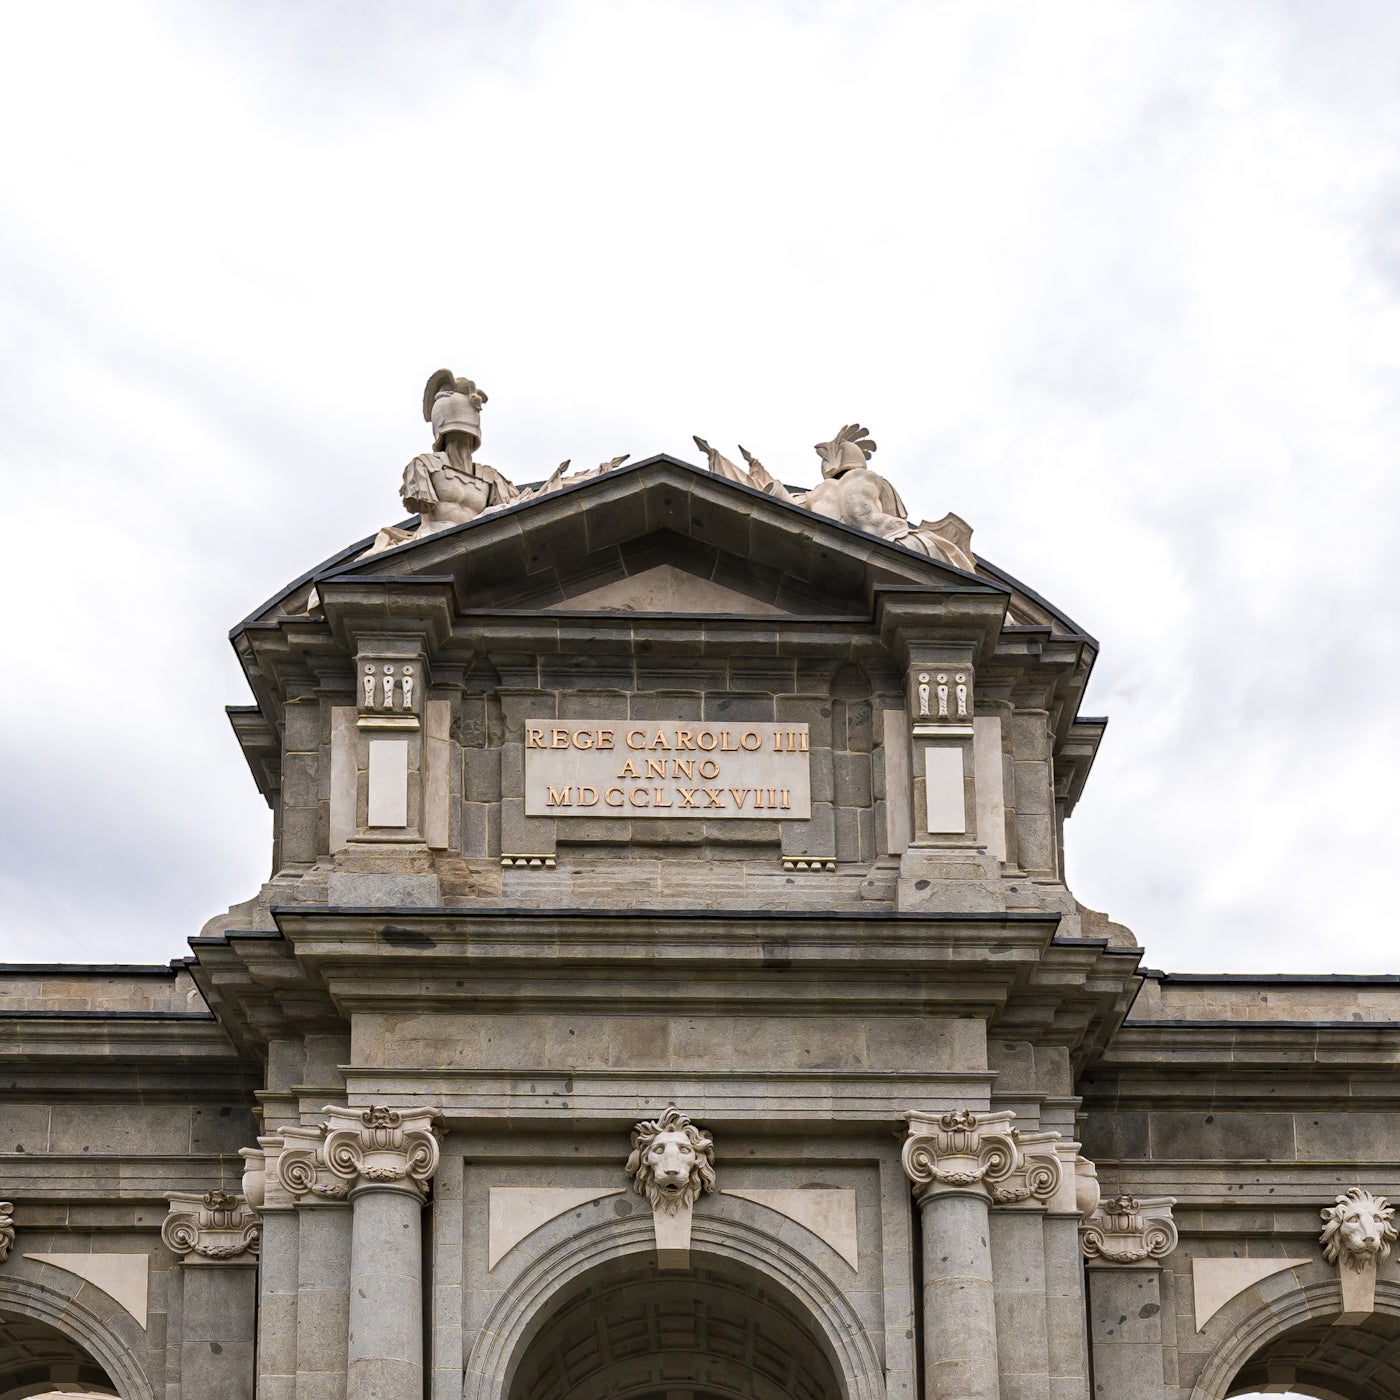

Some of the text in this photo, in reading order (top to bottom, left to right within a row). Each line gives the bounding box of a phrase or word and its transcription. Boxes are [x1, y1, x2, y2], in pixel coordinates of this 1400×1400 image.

[526, 727, 809, 752] REGE CAROLO III
[617, 757, 721, 780] ANNO
[545, 785, 791, 810] MDCCLXXVIII
